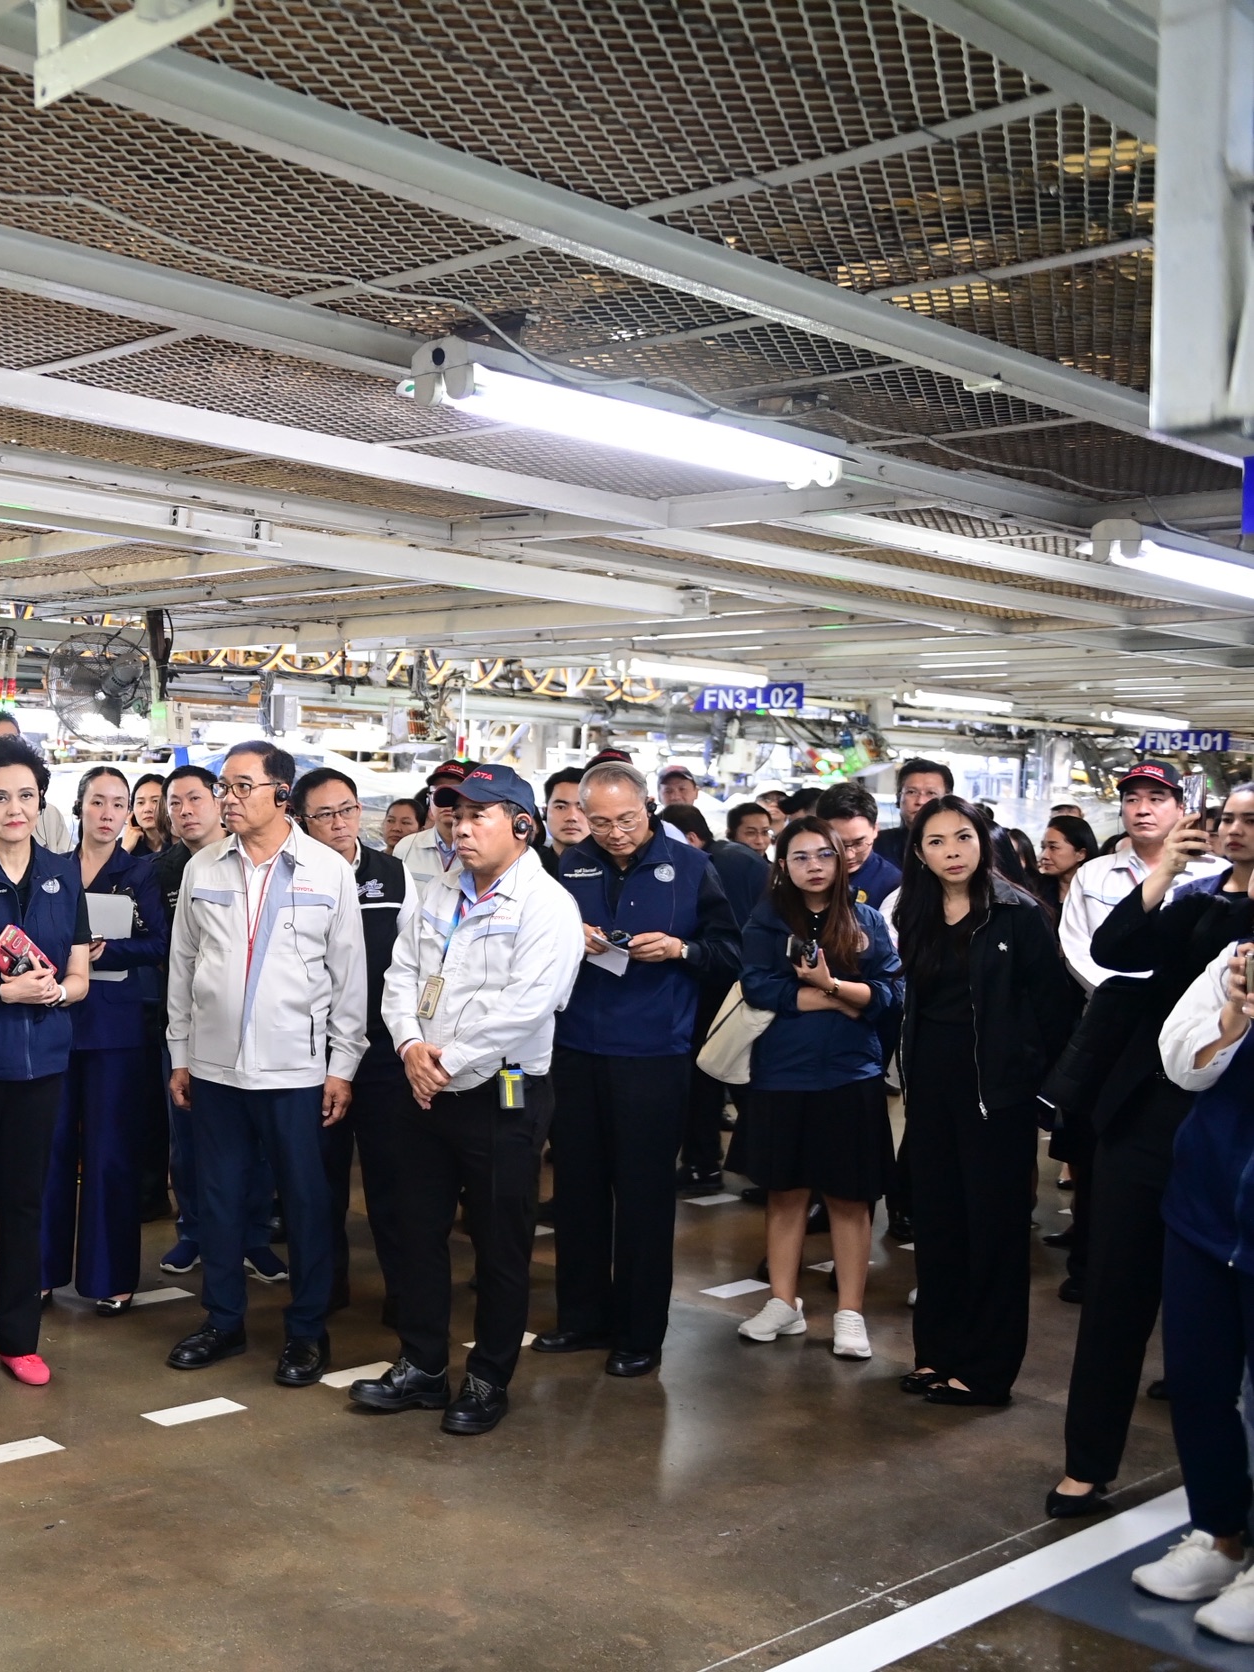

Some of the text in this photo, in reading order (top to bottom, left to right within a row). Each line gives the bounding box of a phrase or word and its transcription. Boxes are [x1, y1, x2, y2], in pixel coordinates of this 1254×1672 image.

[703, 687, 798, 710] FN3-L02
[1145, 732, 1223, 751] FN3-L01
[470, 769, 493, 780] OTA
[1130, 765, 1164, 776] TOYOTA
